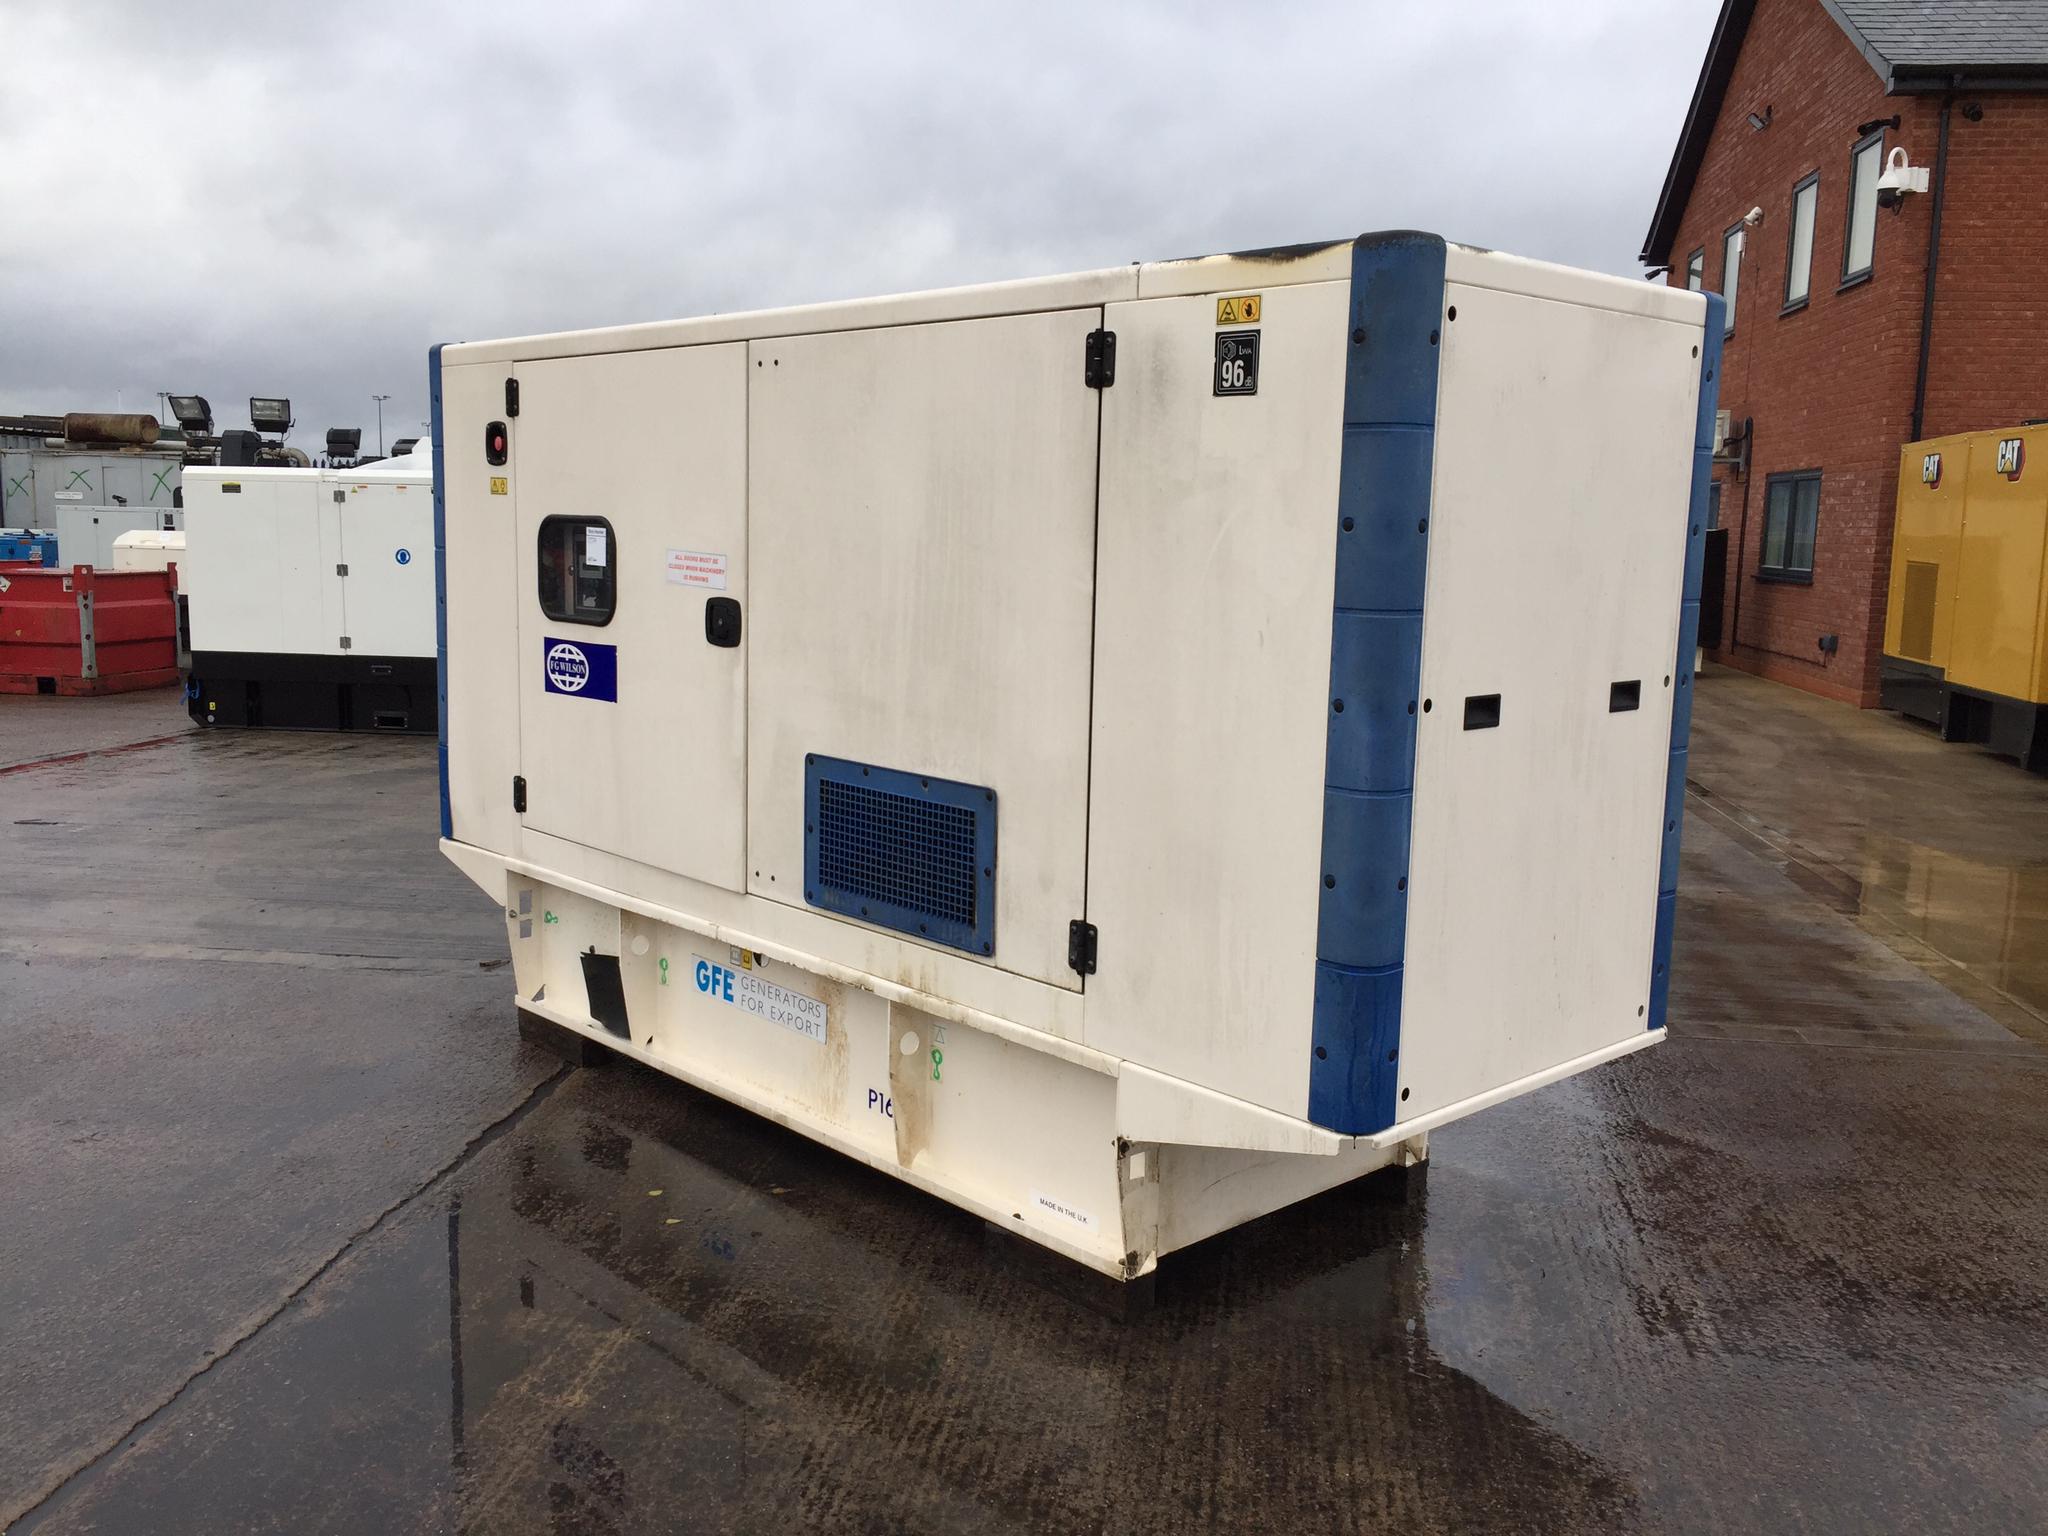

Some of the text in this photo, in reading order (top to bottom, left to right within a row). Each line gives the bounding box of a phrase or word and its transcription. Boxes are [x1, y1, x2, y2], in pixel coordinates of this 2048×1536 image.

[1222, 360, 1244, 387] 96
[1923, 454, 1940, 483] CAT
[1997, 440, 2021, 473] CAT
[550, 660, 586, 674] FG WILSON
[696, 960, 735, 1003] GFE
[741, 975, 821, 1018] GENERATORS
[741, 994, 821, 1038] FOR EXPORT
[1039, 1198, 1057, 1211] MADE
[1057, 1206, 1064, 1214] IN
[1065, 1208, 1076, 1220] THE
